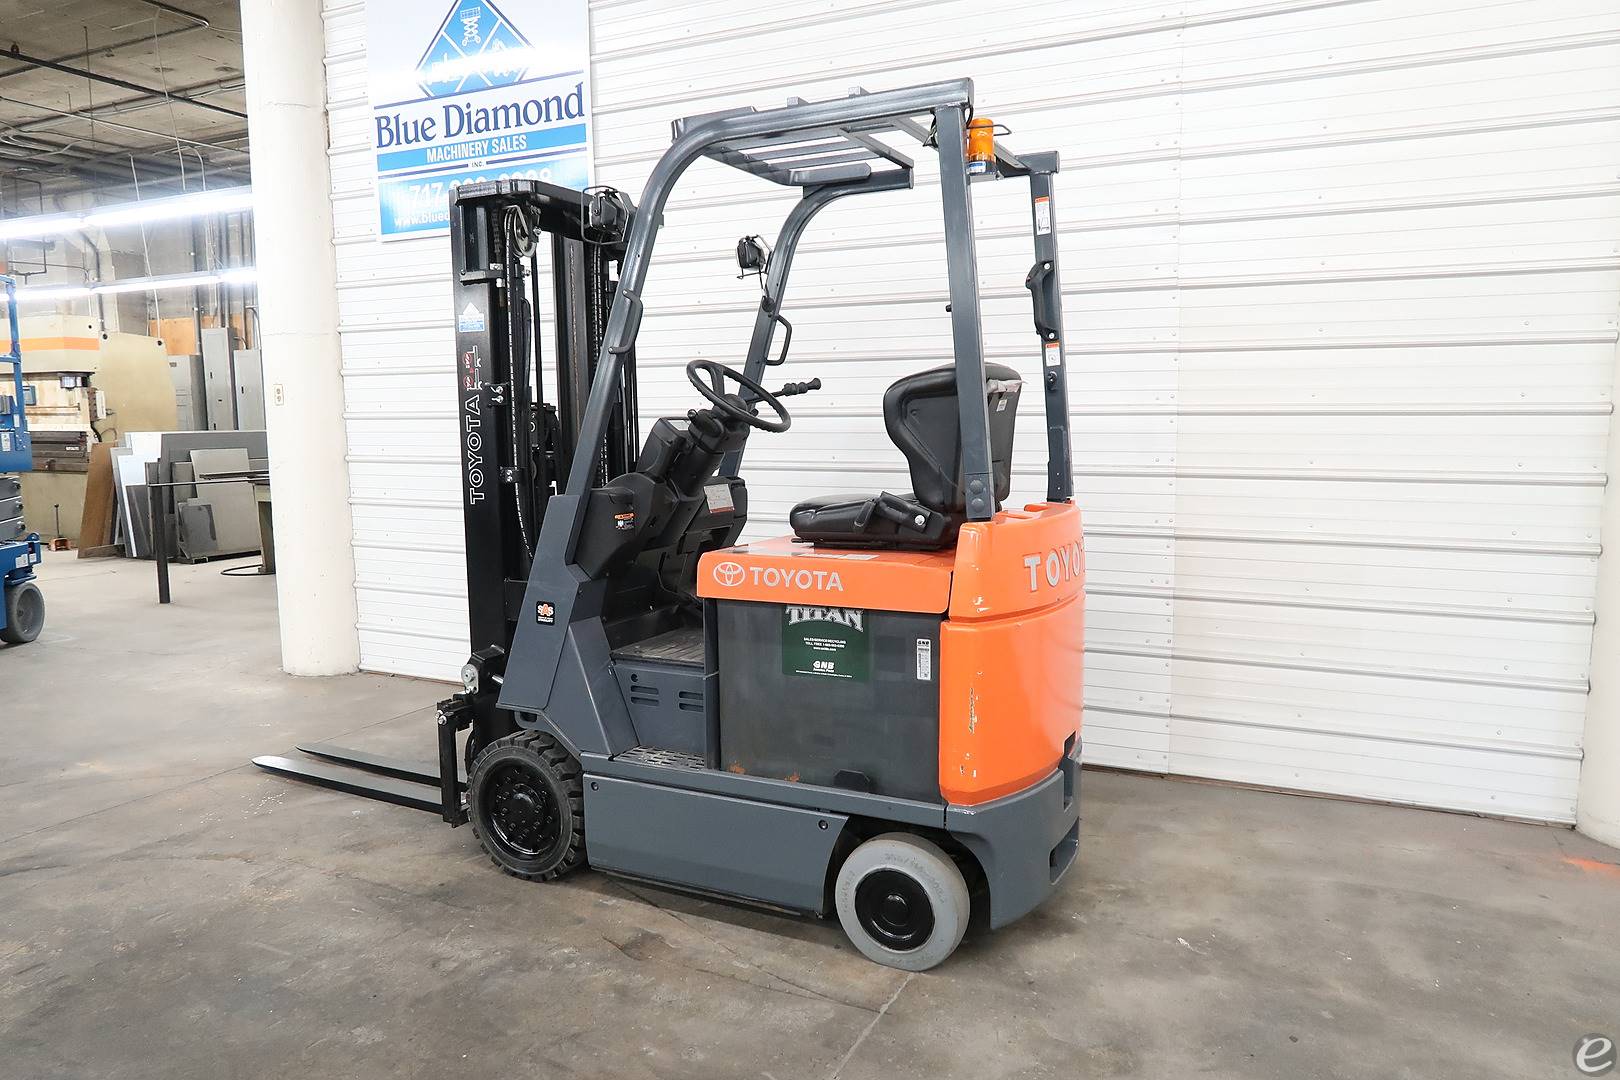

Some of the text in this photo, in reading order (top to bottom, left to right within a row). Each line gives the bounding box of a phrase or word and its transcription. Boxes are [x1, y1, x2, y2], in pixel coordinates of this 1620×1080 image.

[374, 81, 585, 148] Blue Diamond
[426, 134, 527, 163] MACHINERY SALES
[465, 394, 485, 505] TOYOTA
[749, 566, 844, 592] TOYOTA
[1022, 541, 1085, 593] TOYO
[785, 605, 864, 633] TITAN
[812, 660, 835, 670] GNB
